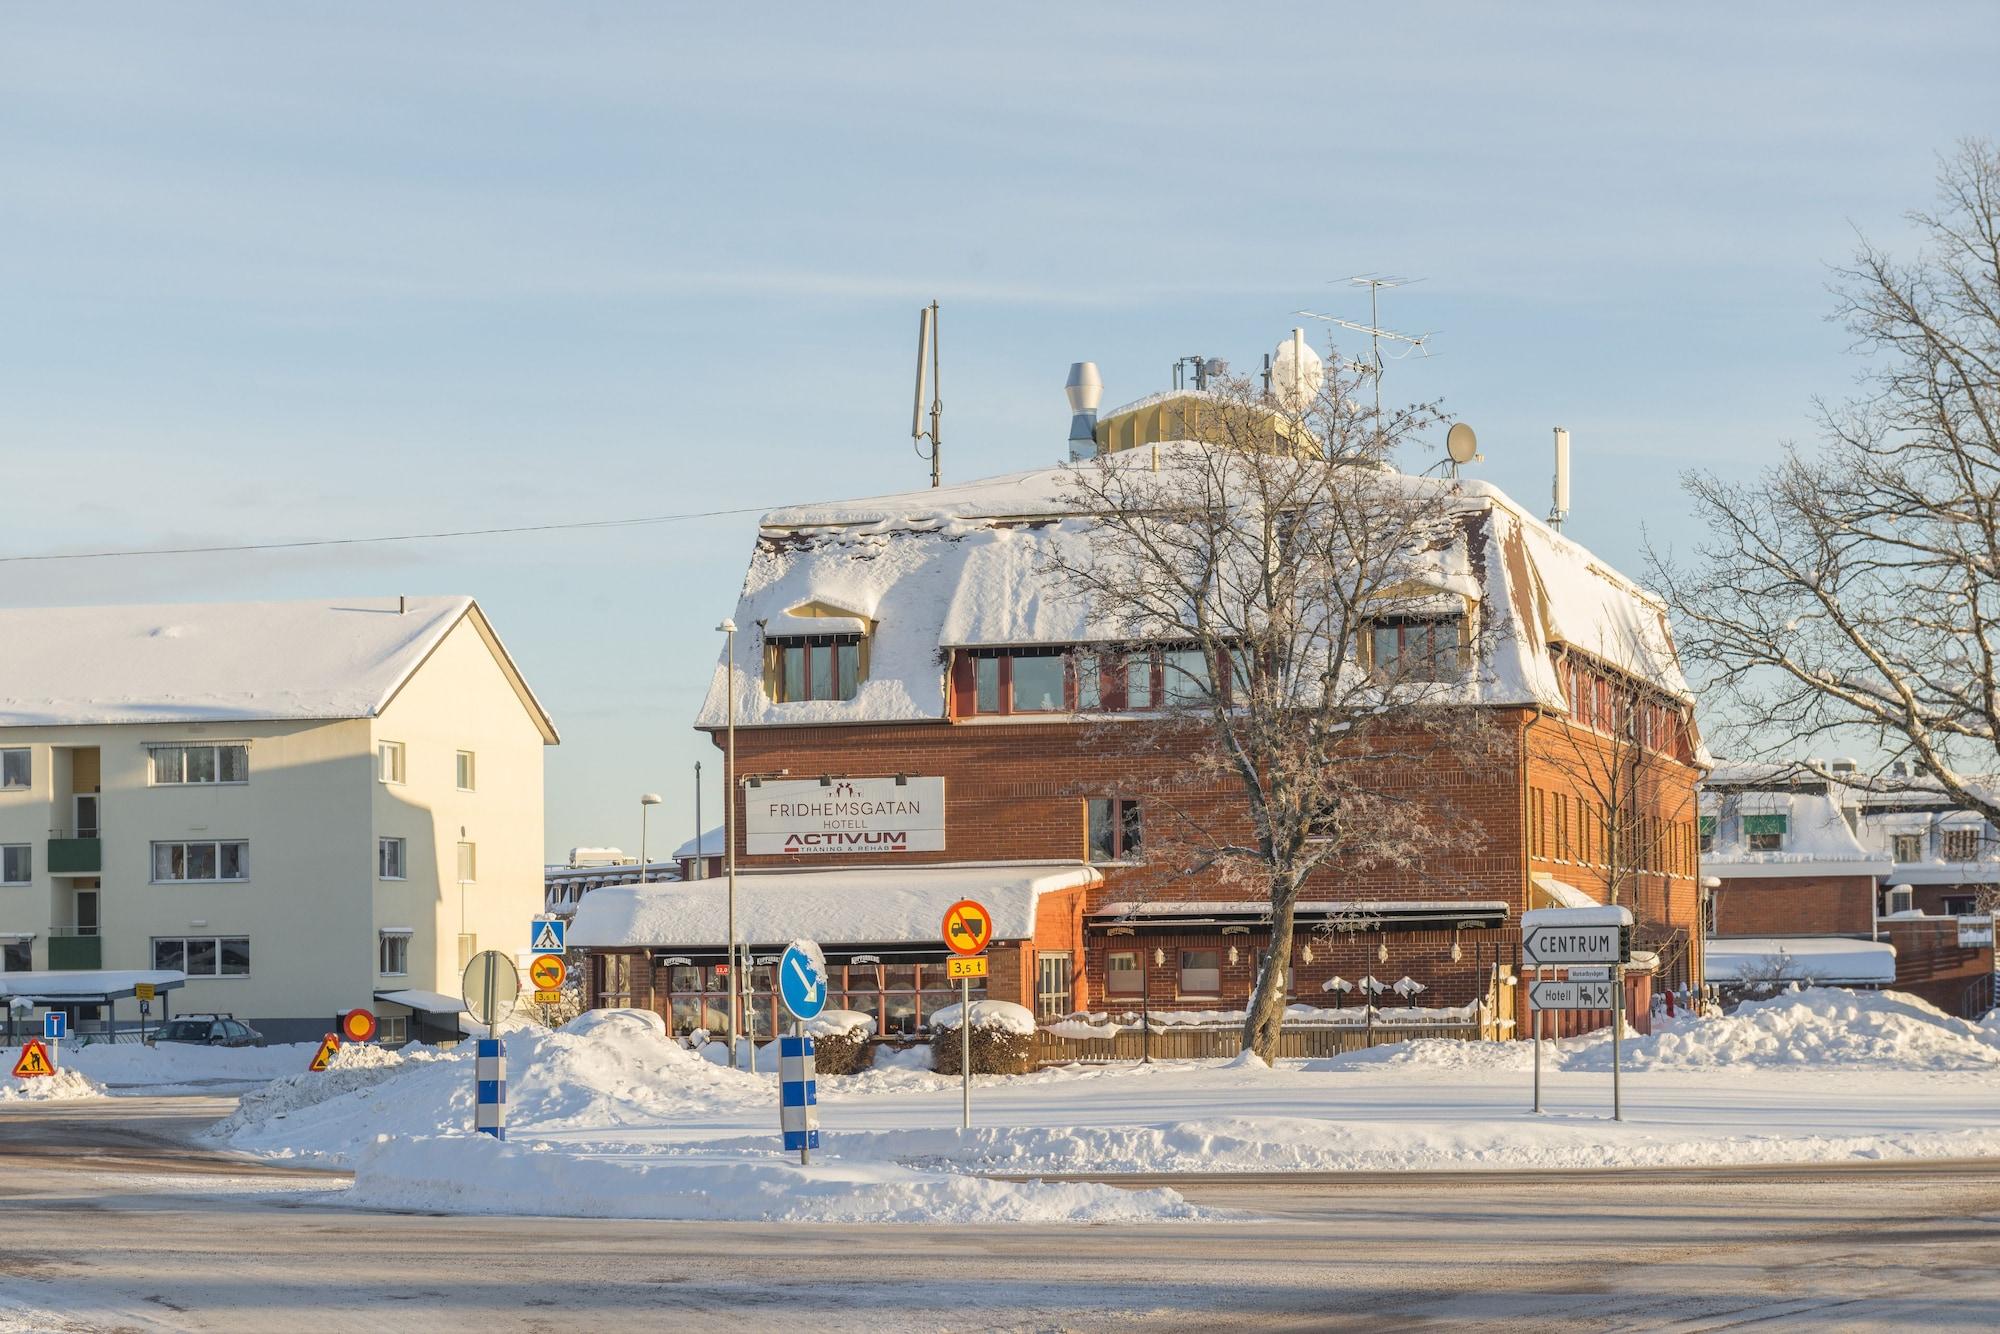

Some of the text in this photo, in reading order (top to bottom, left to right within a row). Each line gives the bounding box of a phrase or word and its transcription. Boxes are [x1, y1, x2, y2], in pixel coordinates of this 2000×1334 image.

[769, 801, 920, 817] FRIDHEMSGATAN
[823, 820, 868, 829] HOTELL
[784, 832, 907, 845] ACTIVUM
[1540, 935, 1610, 953] CENTRUM
[954, 961, 982, 975] 3,5 t
[1545, 989, 1571, 1001] Hotell
